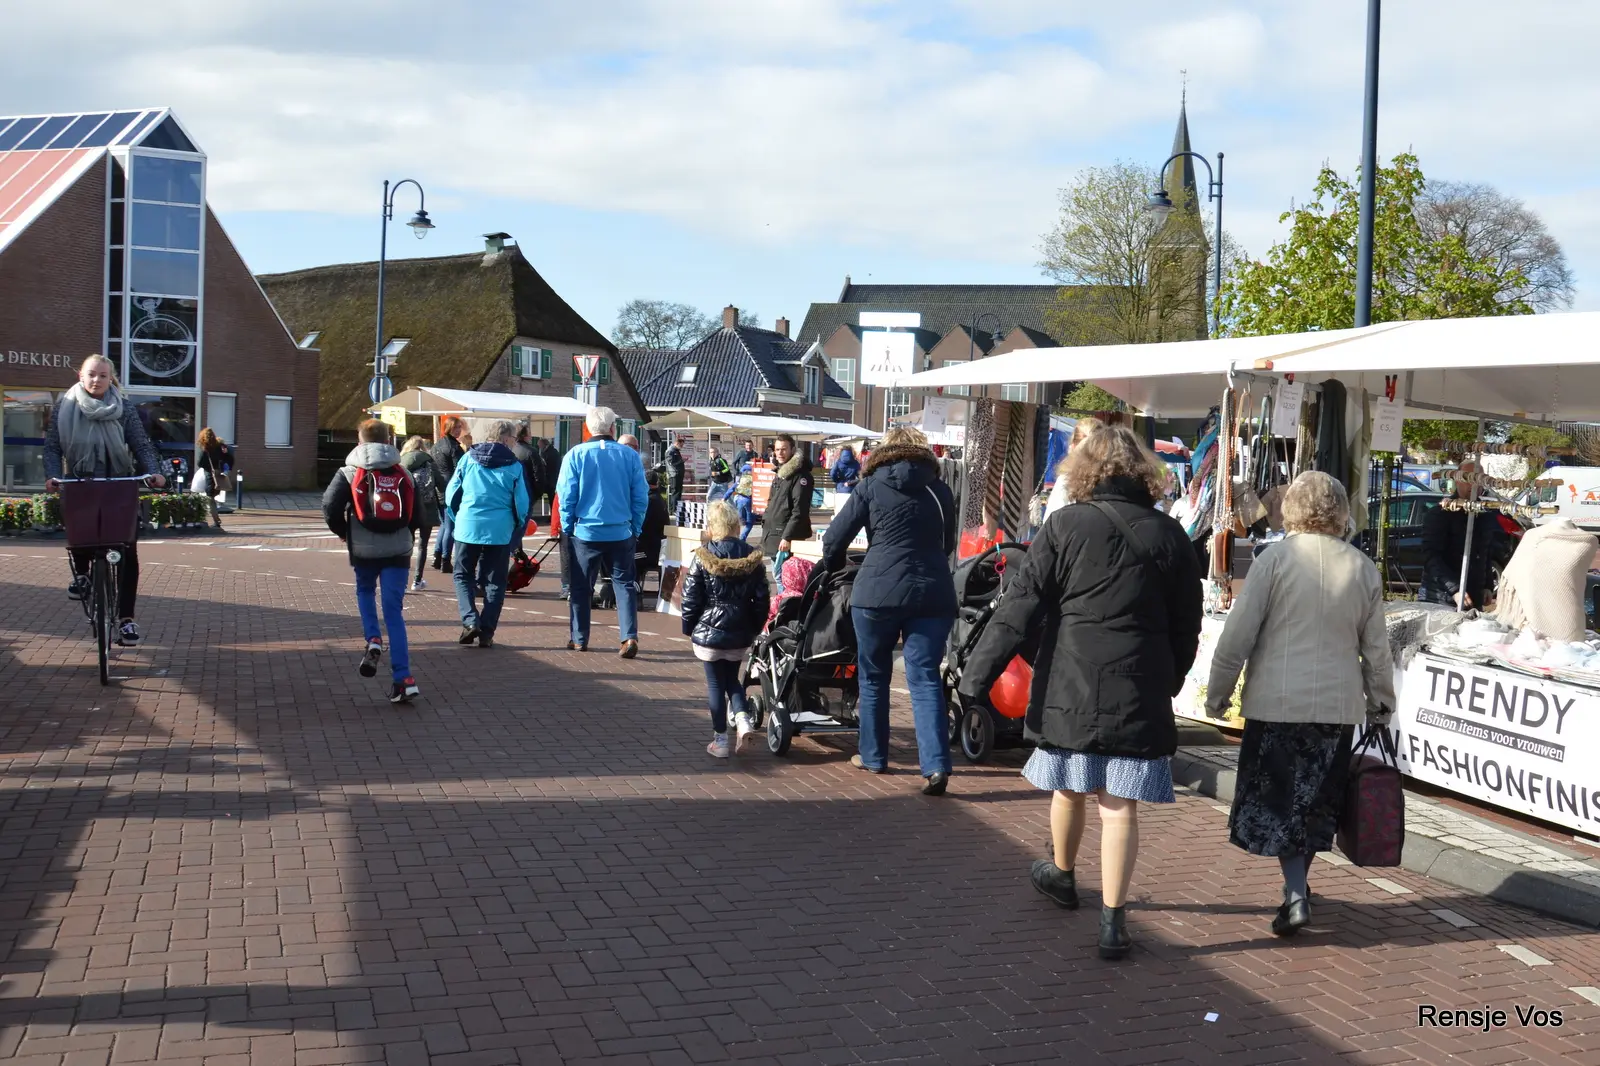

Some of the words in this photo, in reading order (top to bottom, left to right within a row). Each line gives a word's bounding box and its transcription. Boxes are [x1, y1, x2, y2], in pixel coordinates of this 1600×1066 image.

[8, 350, 71, 368] DEKKER
[1426, 665, 1576, 735] TRENDY
[1417, 709, 1457, 732] fashion
[1458, 718, 1489, 740] items
[1490, 731, 1515, 748] voor
[1516, 738, 1564, 761] vrouwen
